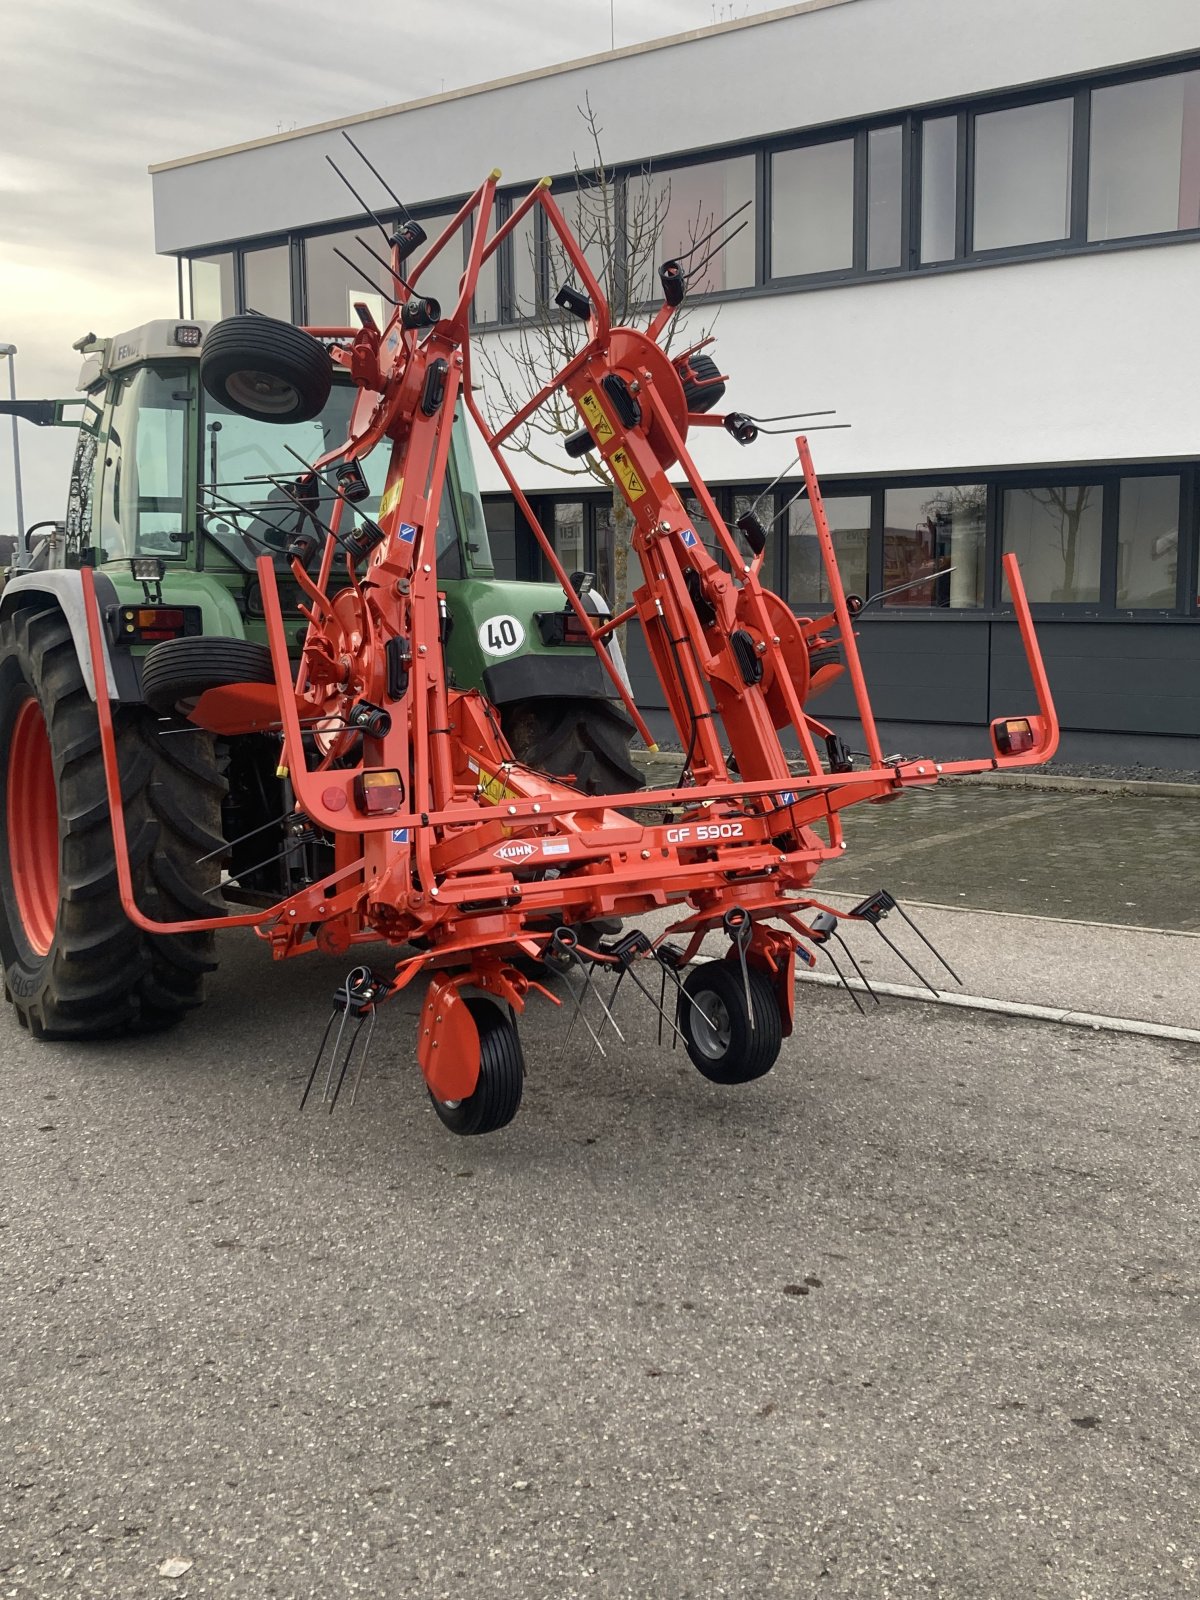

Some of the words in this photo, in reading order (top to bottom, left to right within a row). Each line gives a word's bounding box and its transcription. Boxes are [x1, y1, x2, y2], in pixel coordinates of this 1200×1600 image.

[488, 620, 516, 649] 40
[667, 828, 690, 842] GF
[697, 824, 743, 839] 5902
[500, 845, 532, 858] KUHN
